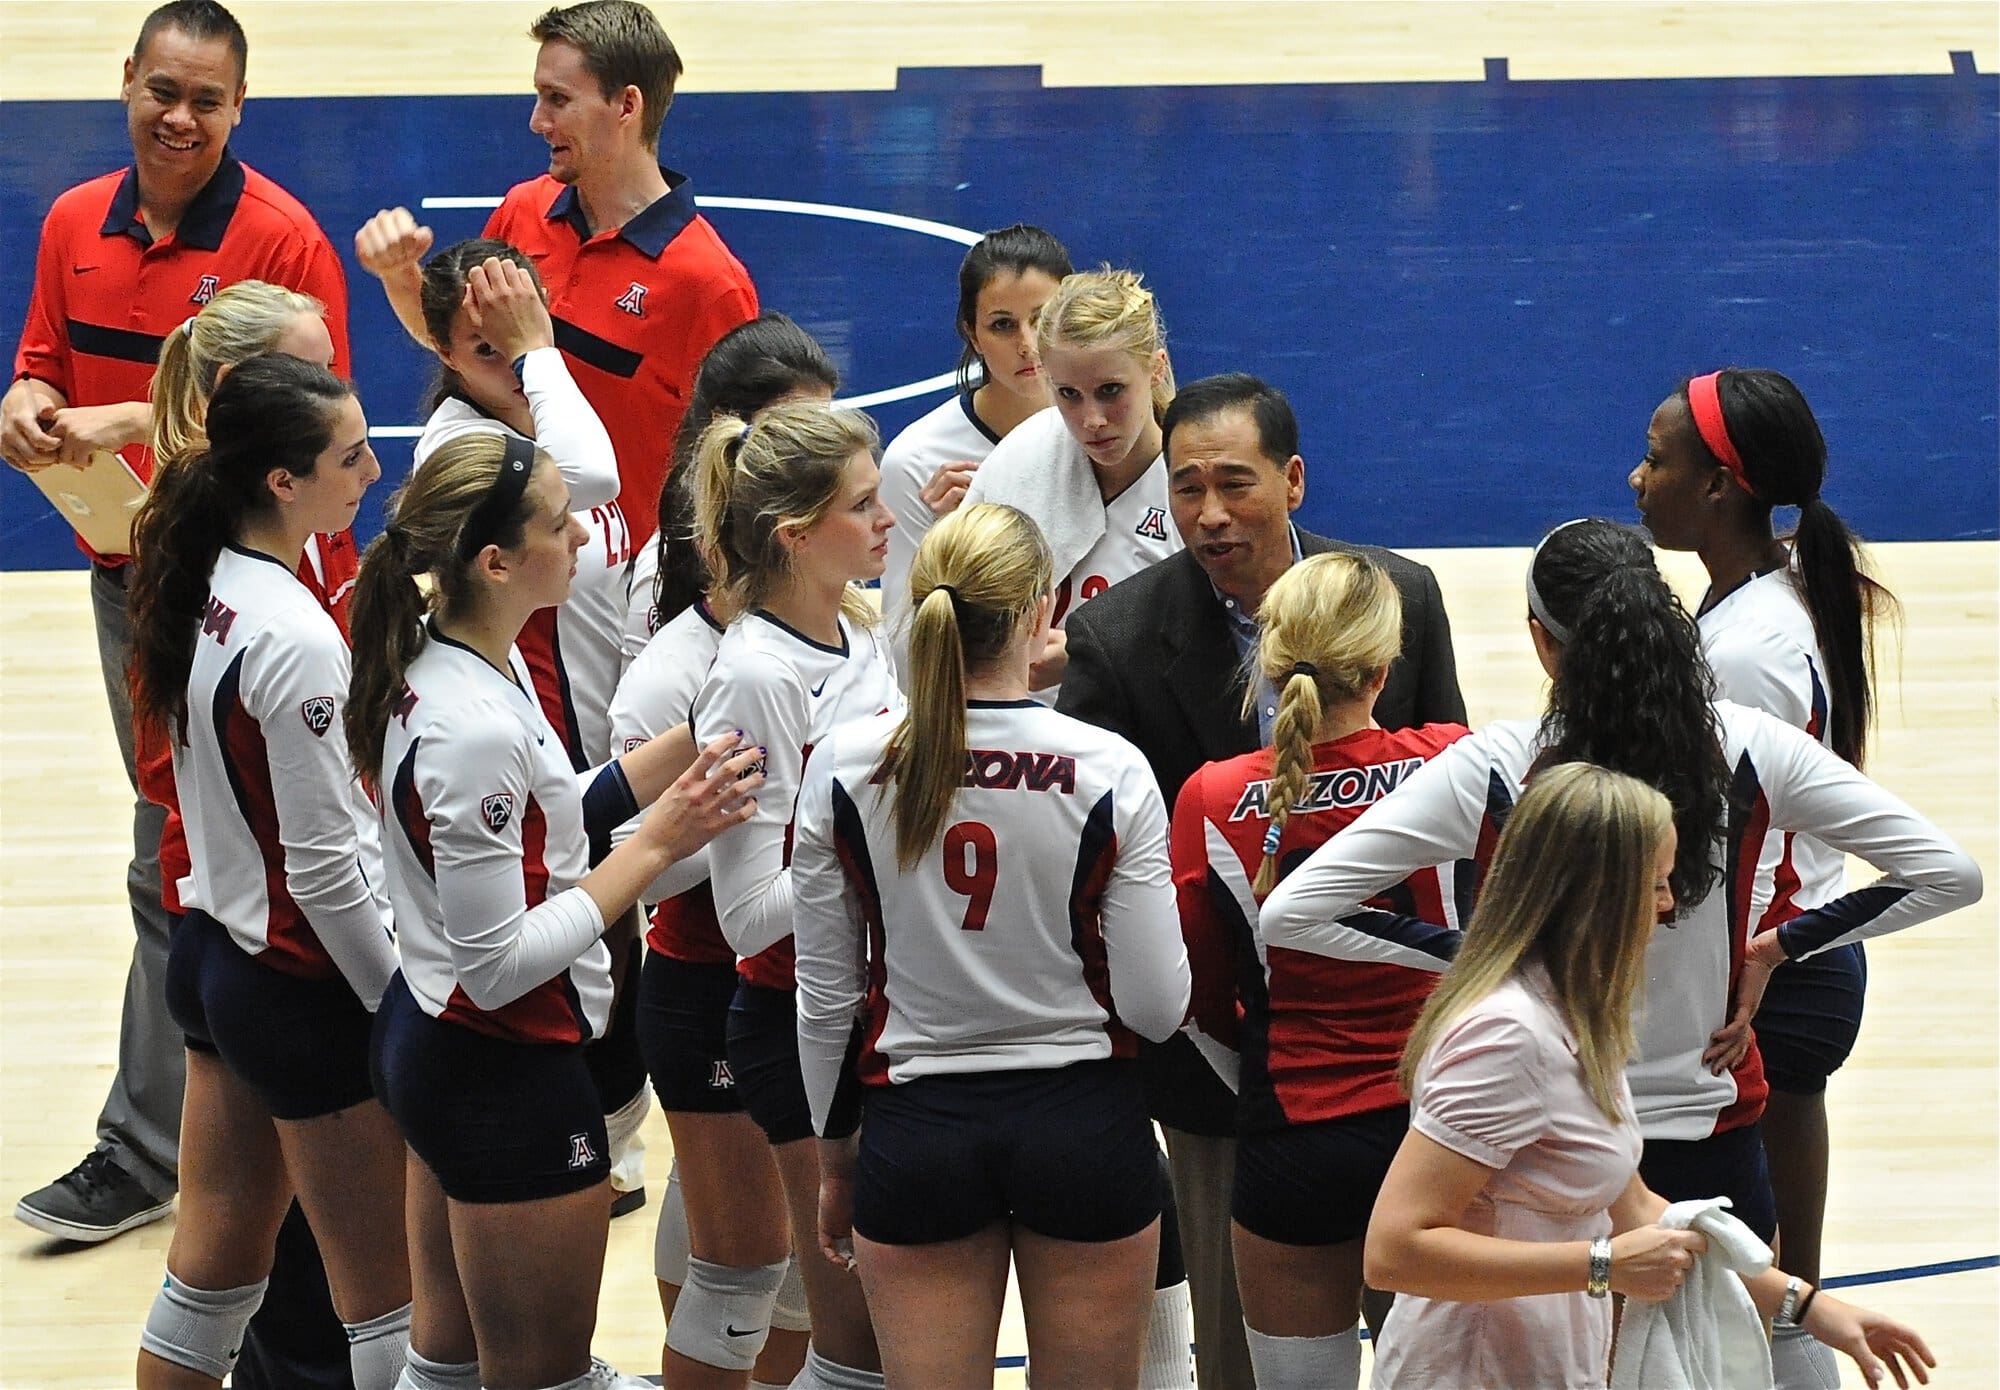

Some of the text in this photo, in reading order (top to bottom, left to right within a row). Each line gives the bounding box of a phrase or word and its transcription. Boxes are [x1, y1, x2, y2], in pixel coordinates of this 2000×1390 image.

[188, 275, 220, 304] A
[614, 281, 648, 318] A
[1135, 506, 1167, 541] A
[304, 698, 333, 722] PAC
[312, 712, 328, 729] 12
[483, 795, 512, 820] PAC
[491, 810, 505, 827] 12
[943, 821, 998, 931] 9
[708, 1059, 735, 1089] A
[568, 1132, 596, 1170] A
